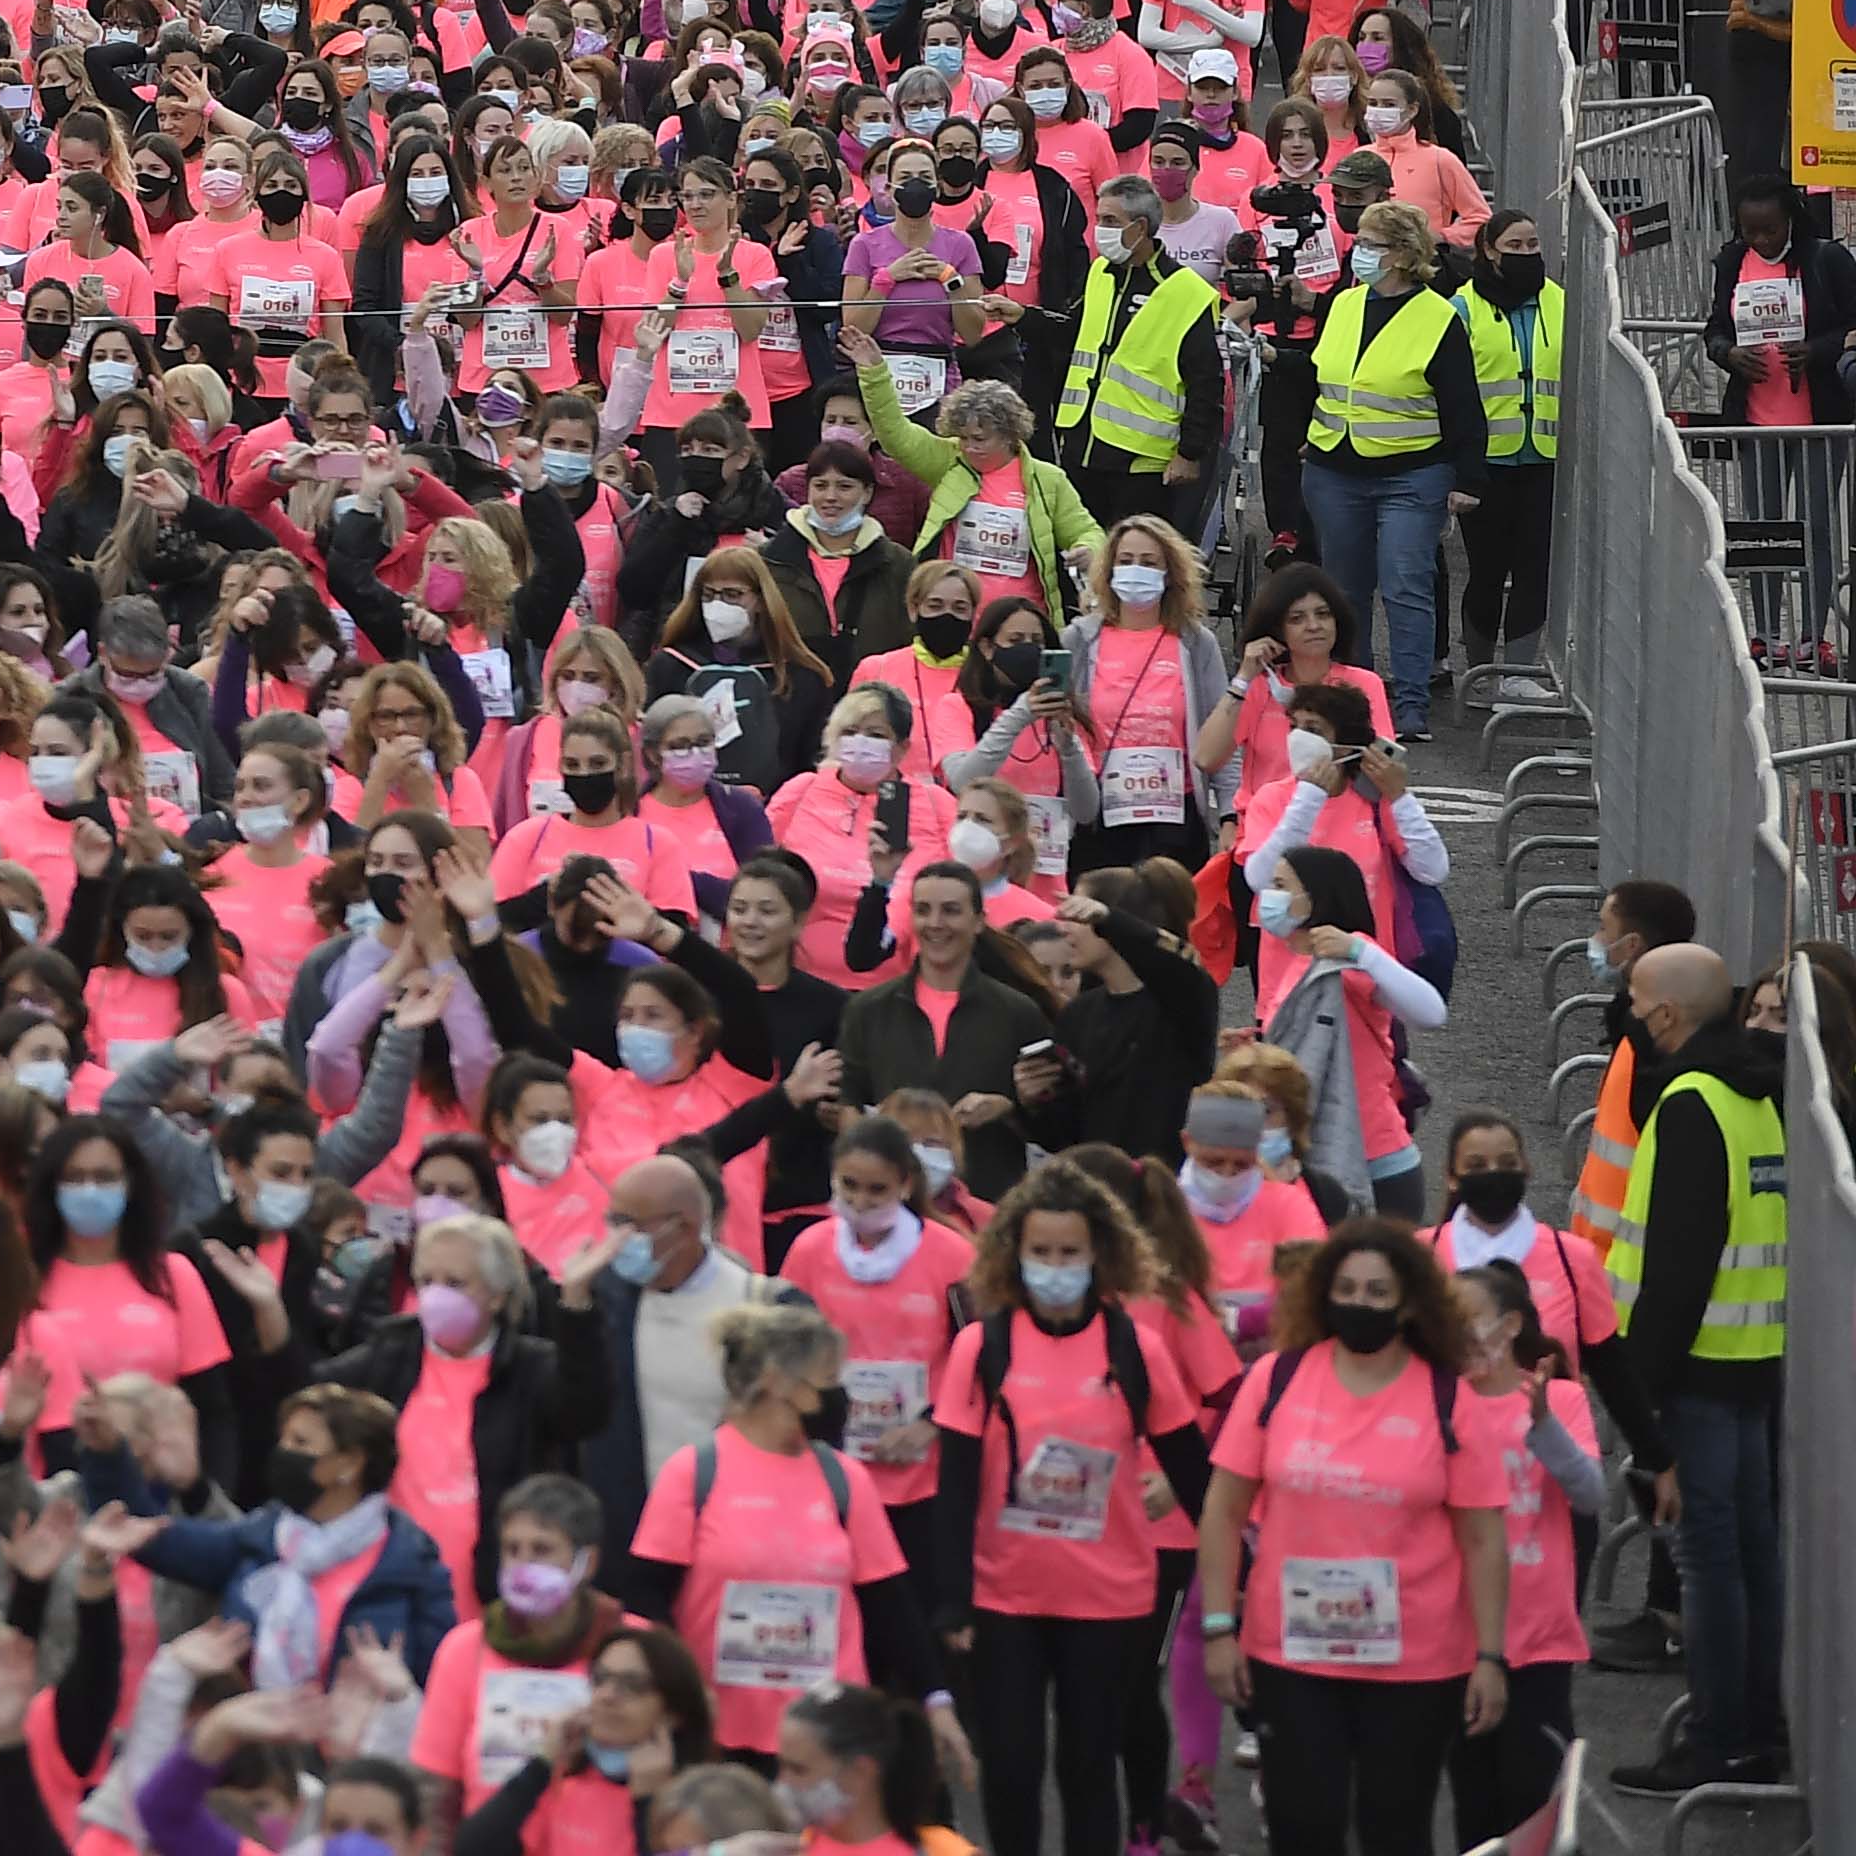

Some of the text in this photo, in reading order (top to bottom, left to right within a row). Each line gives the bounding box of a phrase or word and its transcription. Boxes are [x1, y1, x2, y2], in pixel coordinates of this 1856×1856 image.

[263, 299, 291, 312] 016
[1752, 304, 1782, 318] 016
[500, 329, 529, 342] 016
[688, 353, 717, 367] 016
[895, 378, 925, 393] 016
[977, 529, 1011, 545] 016
[1124, 776, 1161, 791] 016
